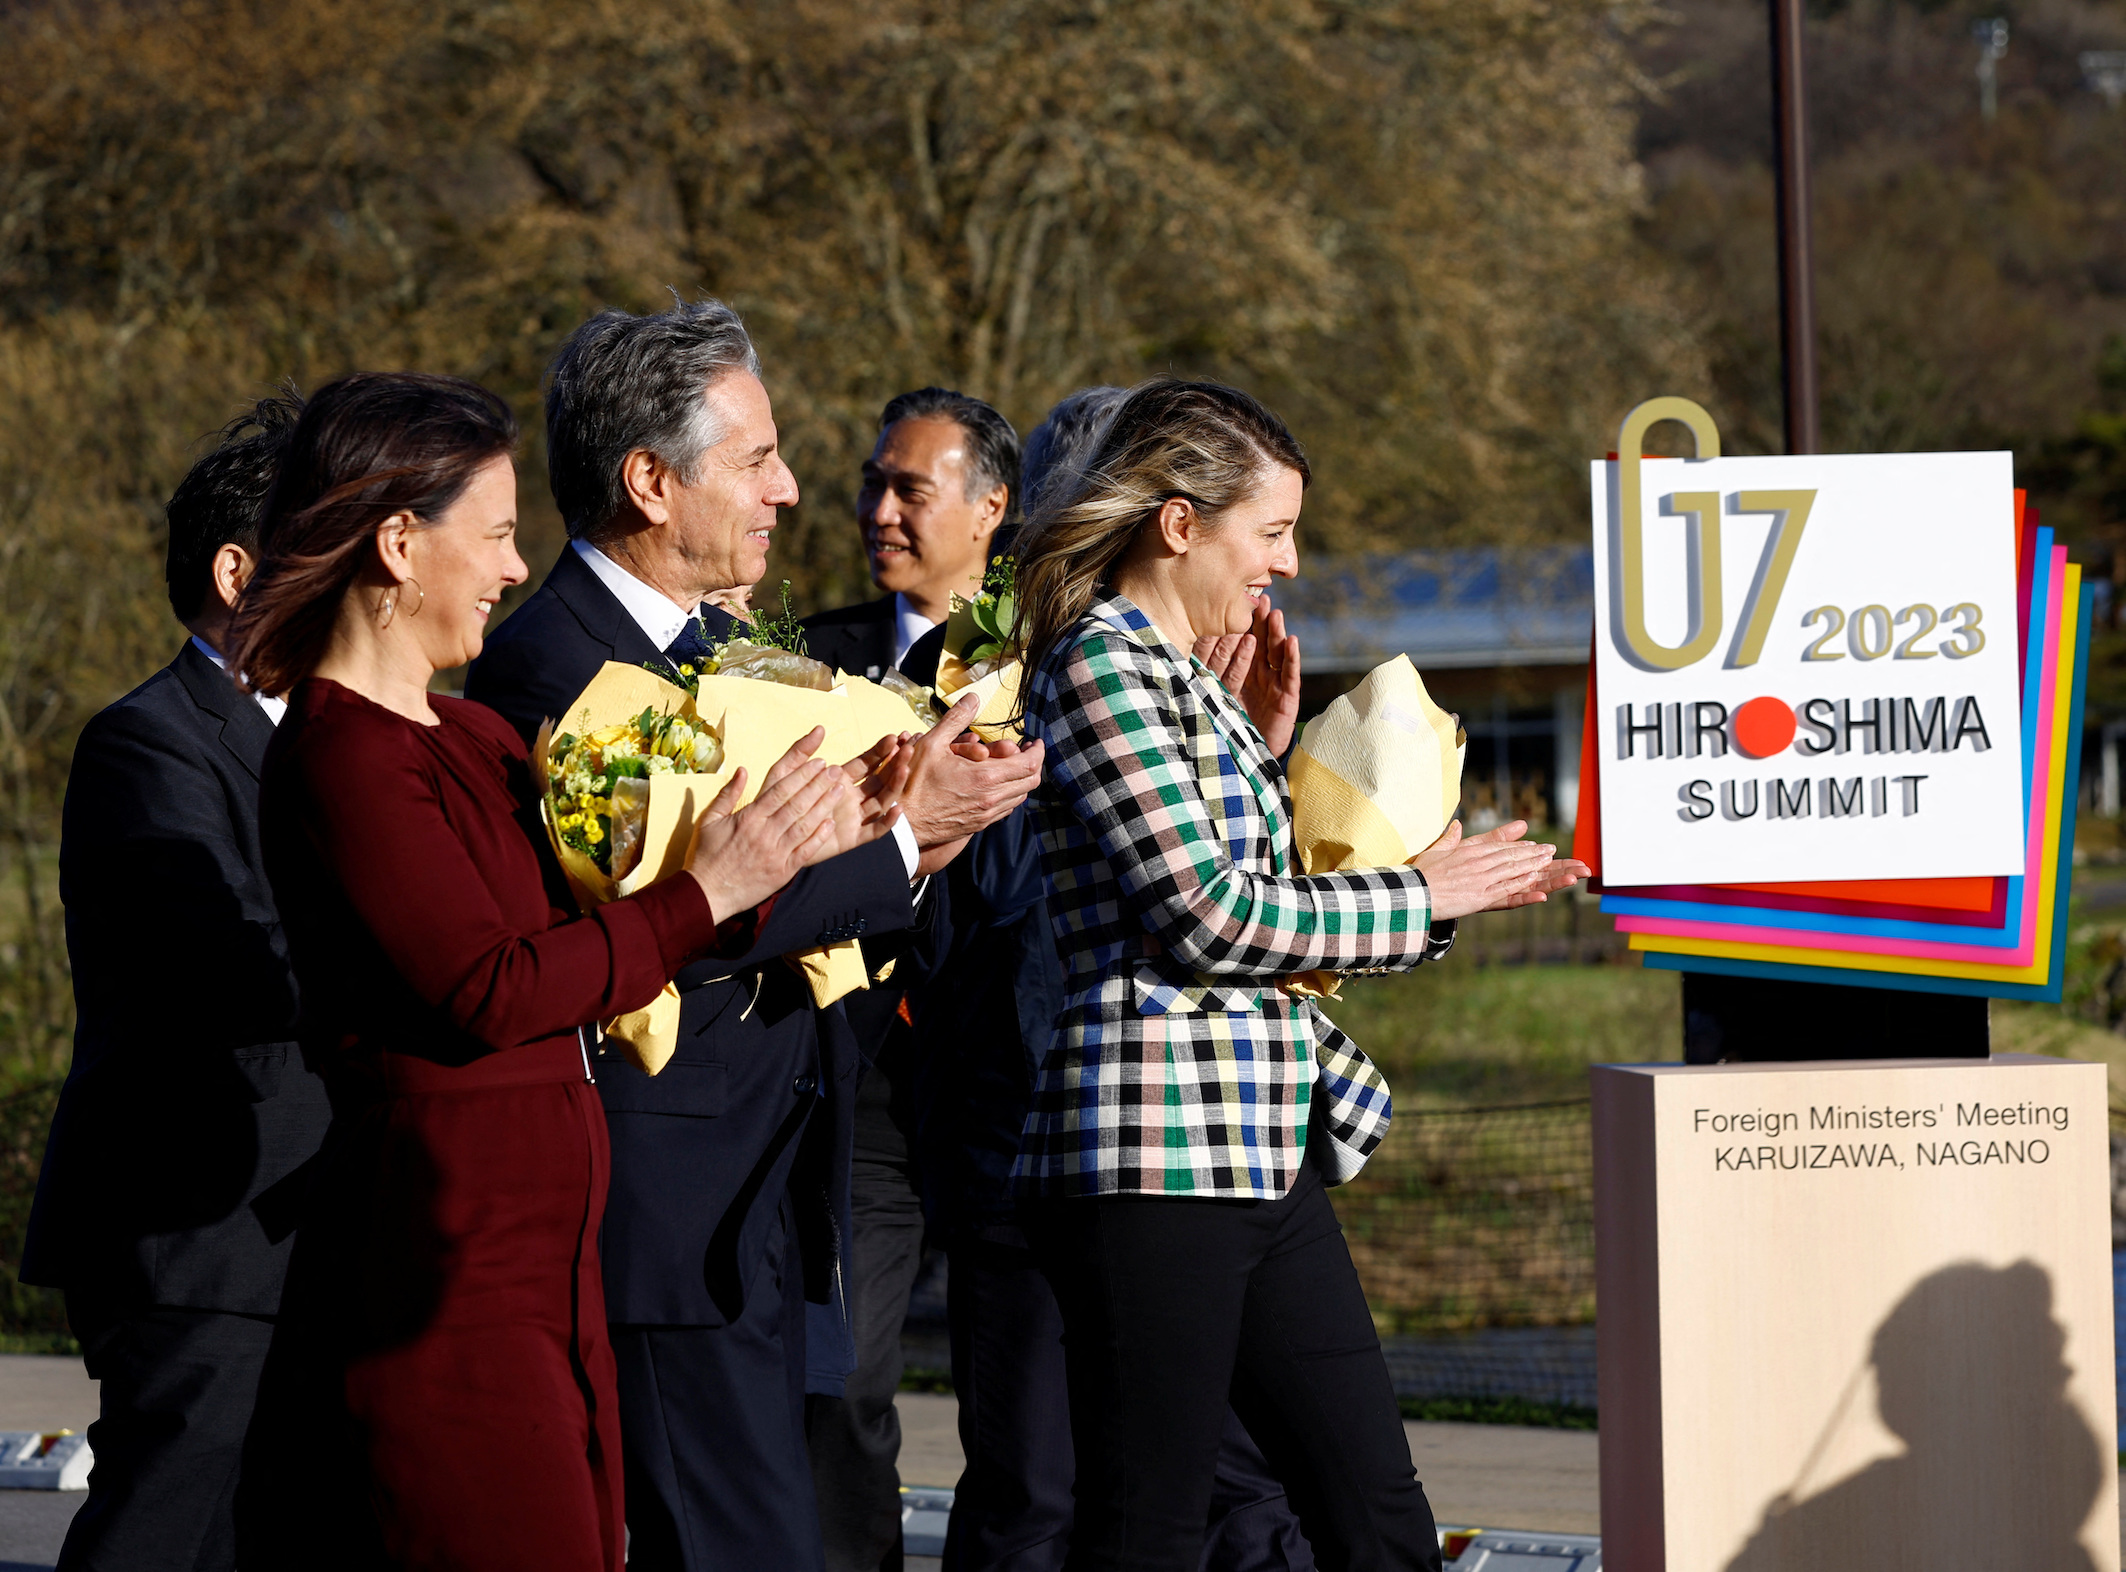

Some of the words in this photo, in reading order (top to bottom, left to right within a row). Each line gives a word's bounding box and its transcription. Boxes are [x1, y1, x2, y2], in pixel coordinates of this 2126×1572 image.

[1615, 396, 1819, 671] G7
[1803, 602, 1986, 661] 2023
[1621, 695, 1992, 758] HIROSHIMA
[1682, 774, 1929, 819] SUMMIT
[1693, 1107, 1799, 1137] Foreign
[1809, 1103, 1945, 1131] Ministers'
[1956, 1101, 2070, 1131] Meeting
[1714, 1143, 1906, 1172] KARUIZAWA,
[1916, 1139, 2051, 1167] NAGANO
